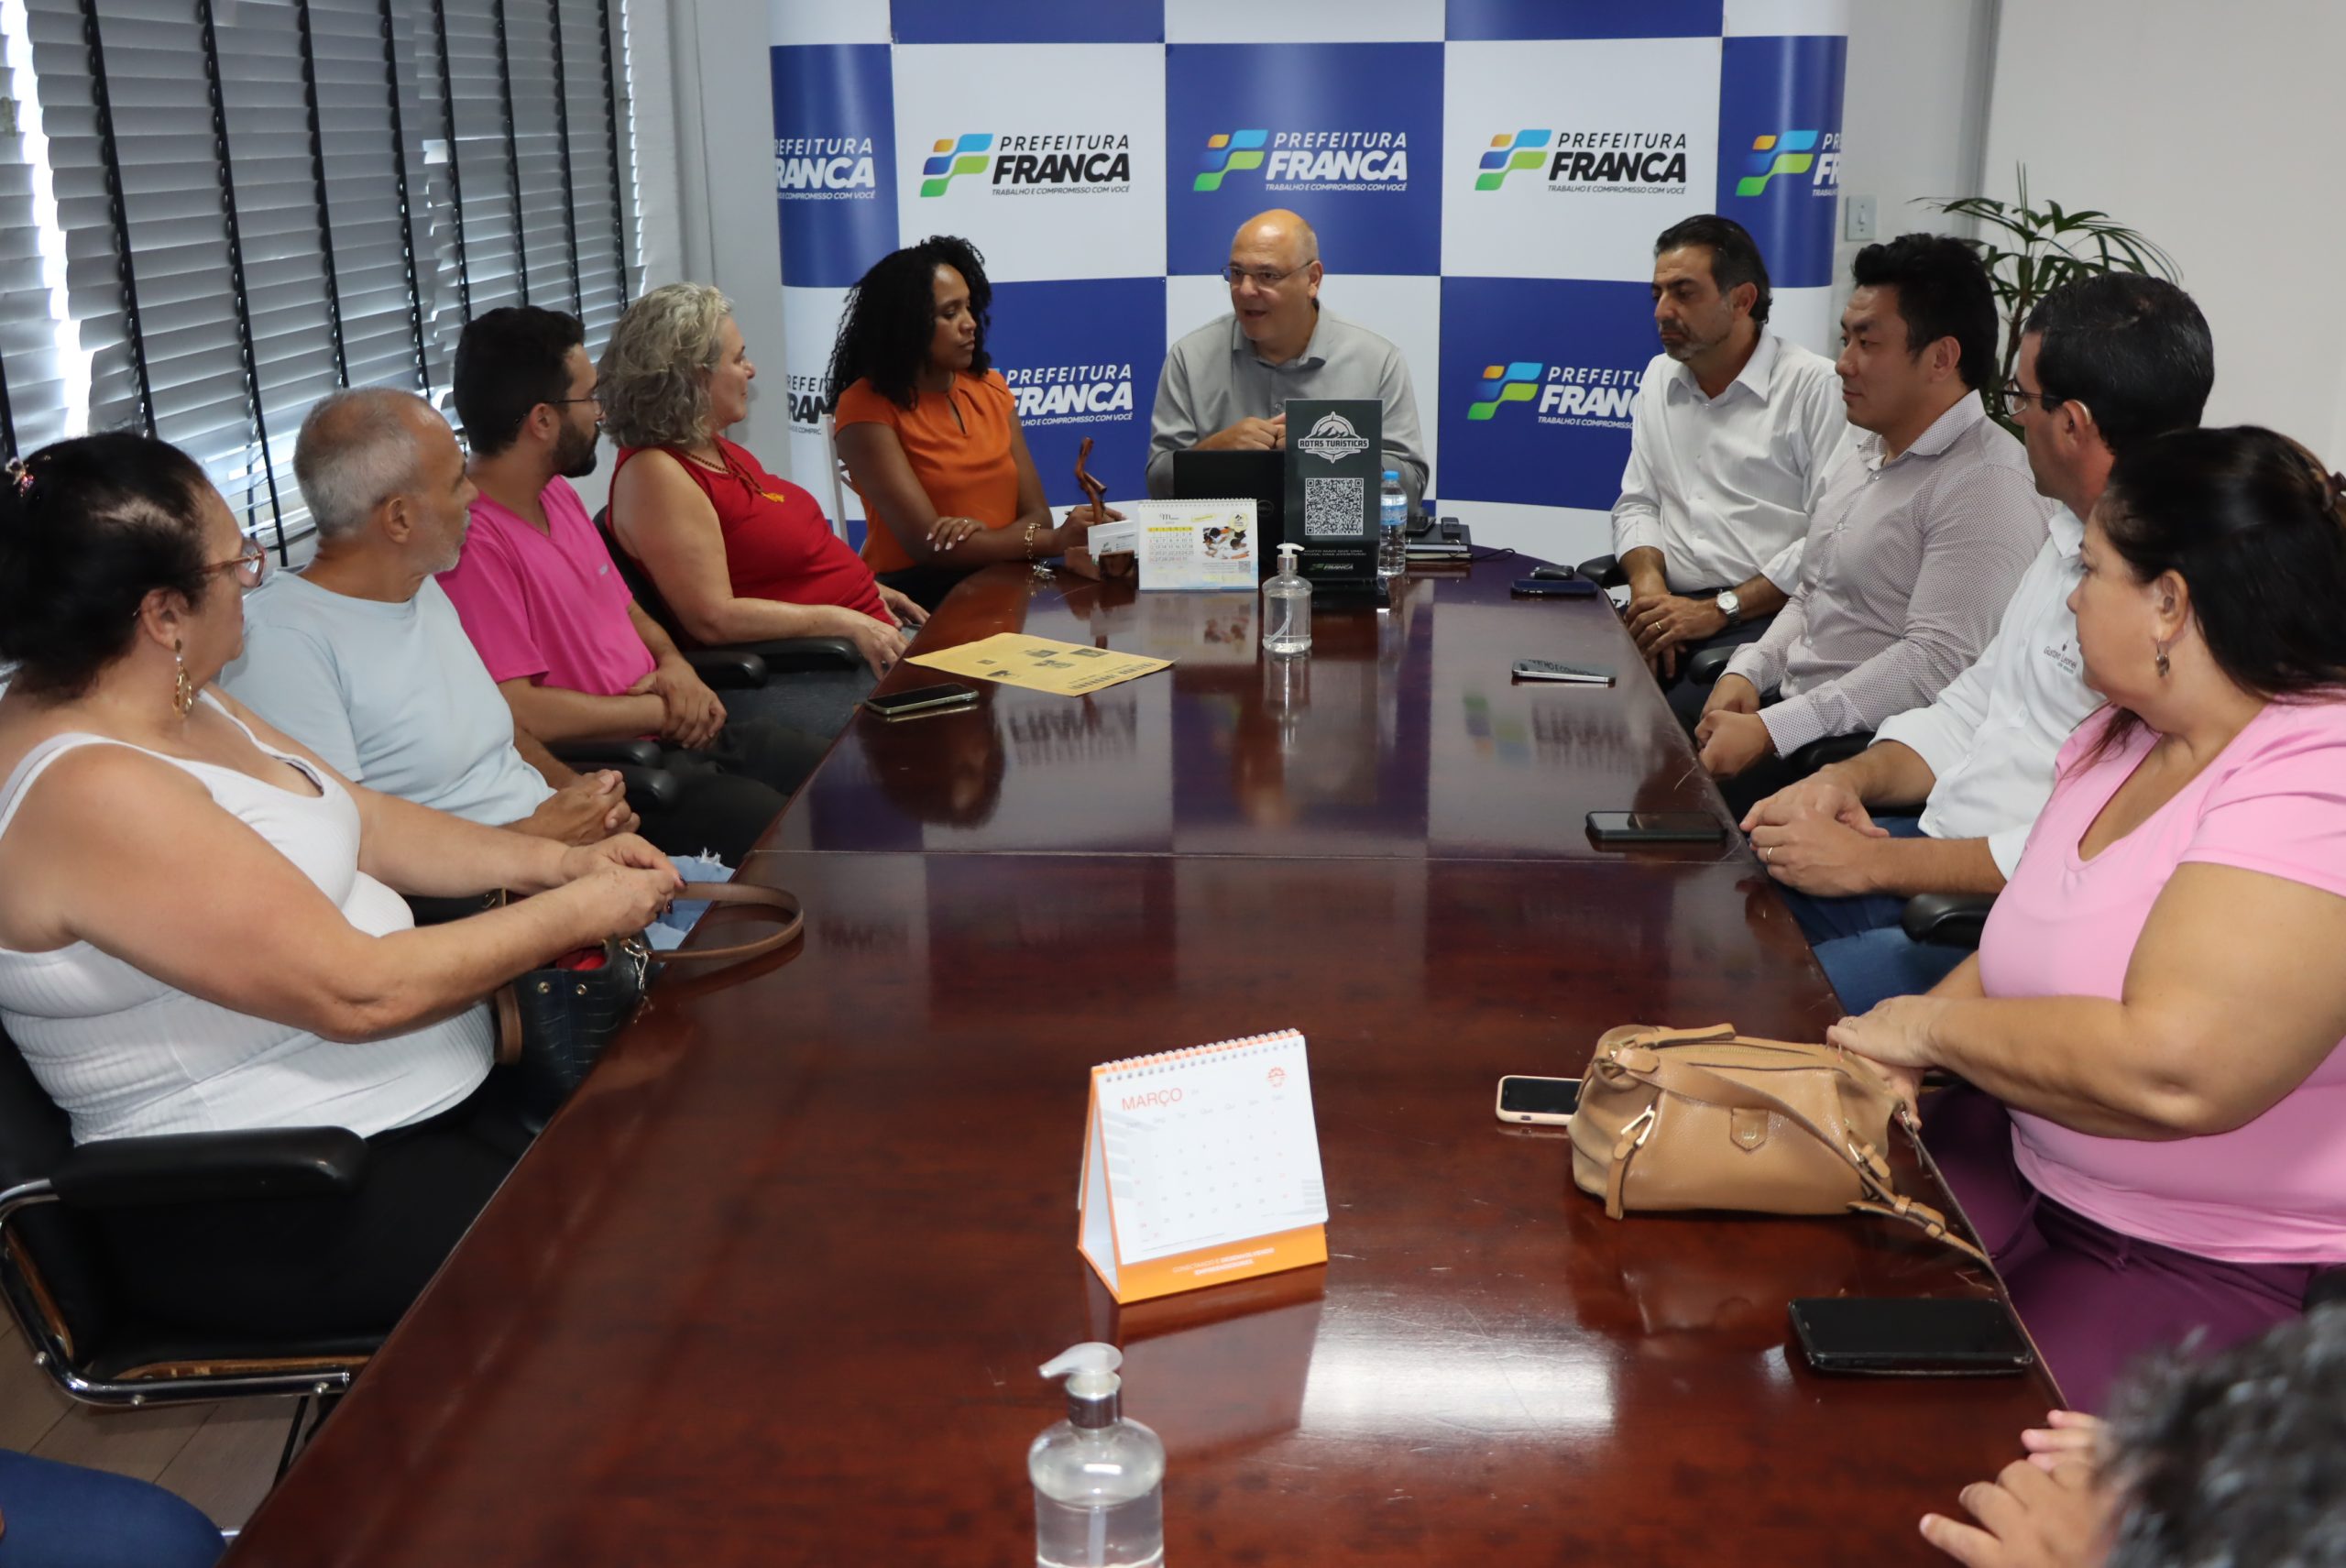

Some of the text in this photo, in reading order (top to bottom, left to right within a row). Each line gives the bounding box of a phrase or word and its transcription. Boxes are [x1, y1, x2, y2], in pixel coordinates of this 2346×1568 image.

[775, 137, 872, 155] REFEITURA
[1000, 135, 1128, 151] PREFEITURA
[1275, 132, 1406, 148] PREFEITURA
[1558, 132, 1685, 148] PREFEITURA
[777, 157, 875, 189] RANCA
[992, 153, 1130, 184] FRANCA
[1266, 150, 1407, 181] FRANCA
[1549, 151, 1686, 182] FRANCA
[1007, 364, 1131, 384] PREFEITURA
[1548, 366, 1640, 386] PREFEITU
[1539, 384, 1635, 417] FRAN
[1042, 416, 1094, 425] COMPROMISSO
[1538, 416, 1575, 424] TRABALHO
[1122, 1088, 1182, 1111] MARÇO
